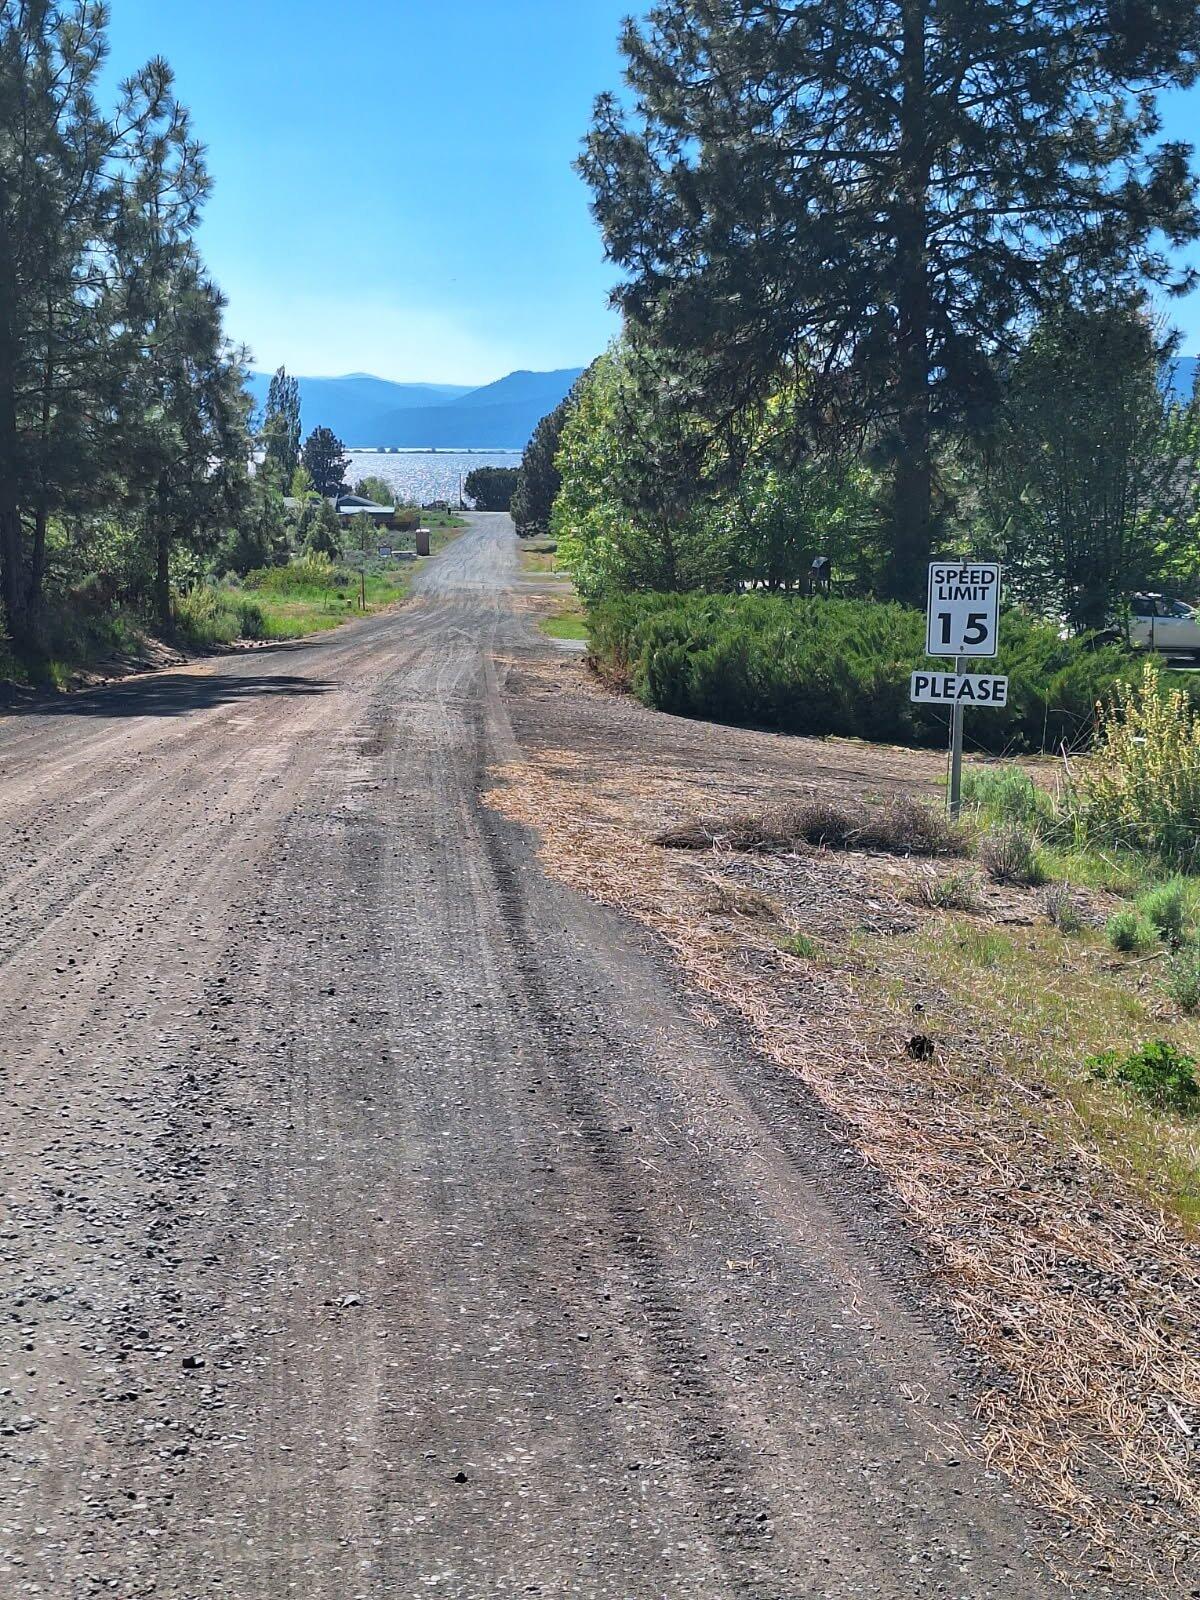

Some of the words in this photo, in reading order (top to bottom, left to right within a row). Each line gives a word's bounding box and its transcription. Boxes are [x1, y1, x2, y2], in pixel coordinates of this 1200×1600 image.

[935, 570, 995, 584] SPEED
[938, 586, 989, 600] LIMIT
[938, 613, 988, 645] 15
[914, 676, 1005, 701] PLEASE
